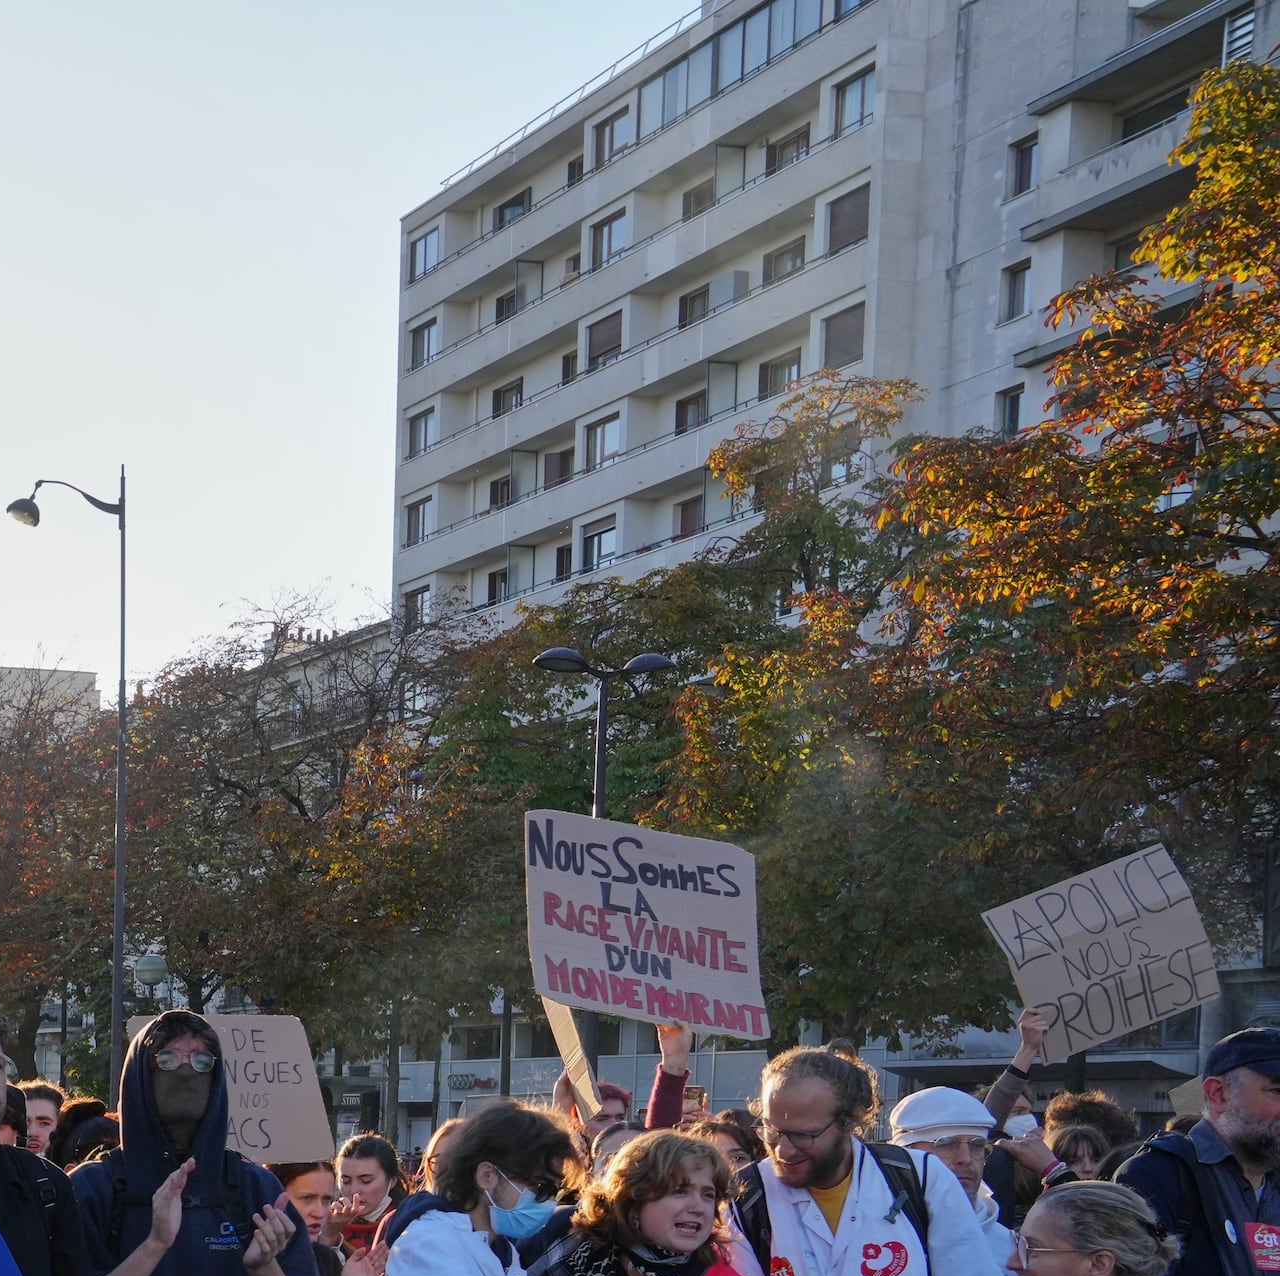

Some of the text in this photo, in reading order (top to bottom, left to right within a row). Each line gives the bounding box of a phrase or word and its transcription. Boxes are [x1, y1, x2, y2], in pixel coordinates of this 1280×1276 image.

[544, 891, 620, 943] RAGE
[600, 882, 658, 921] LA
[987, 847, 1192, 971] LA POLICE
[604, 944, 672, 980] D'UN
[1062, 926, 1152, 987] NOUS
[544, 954, 766, 1037] MONDE MOURANT
[231, 1028, 266, 1053] DE
[224, 1058, 303, 1085] NGUES
[240, 1092, 271, 1109] NOS
[227, 1115, 272, 1150] ACS
[1254, 1232, 1279, 1247] cgt
